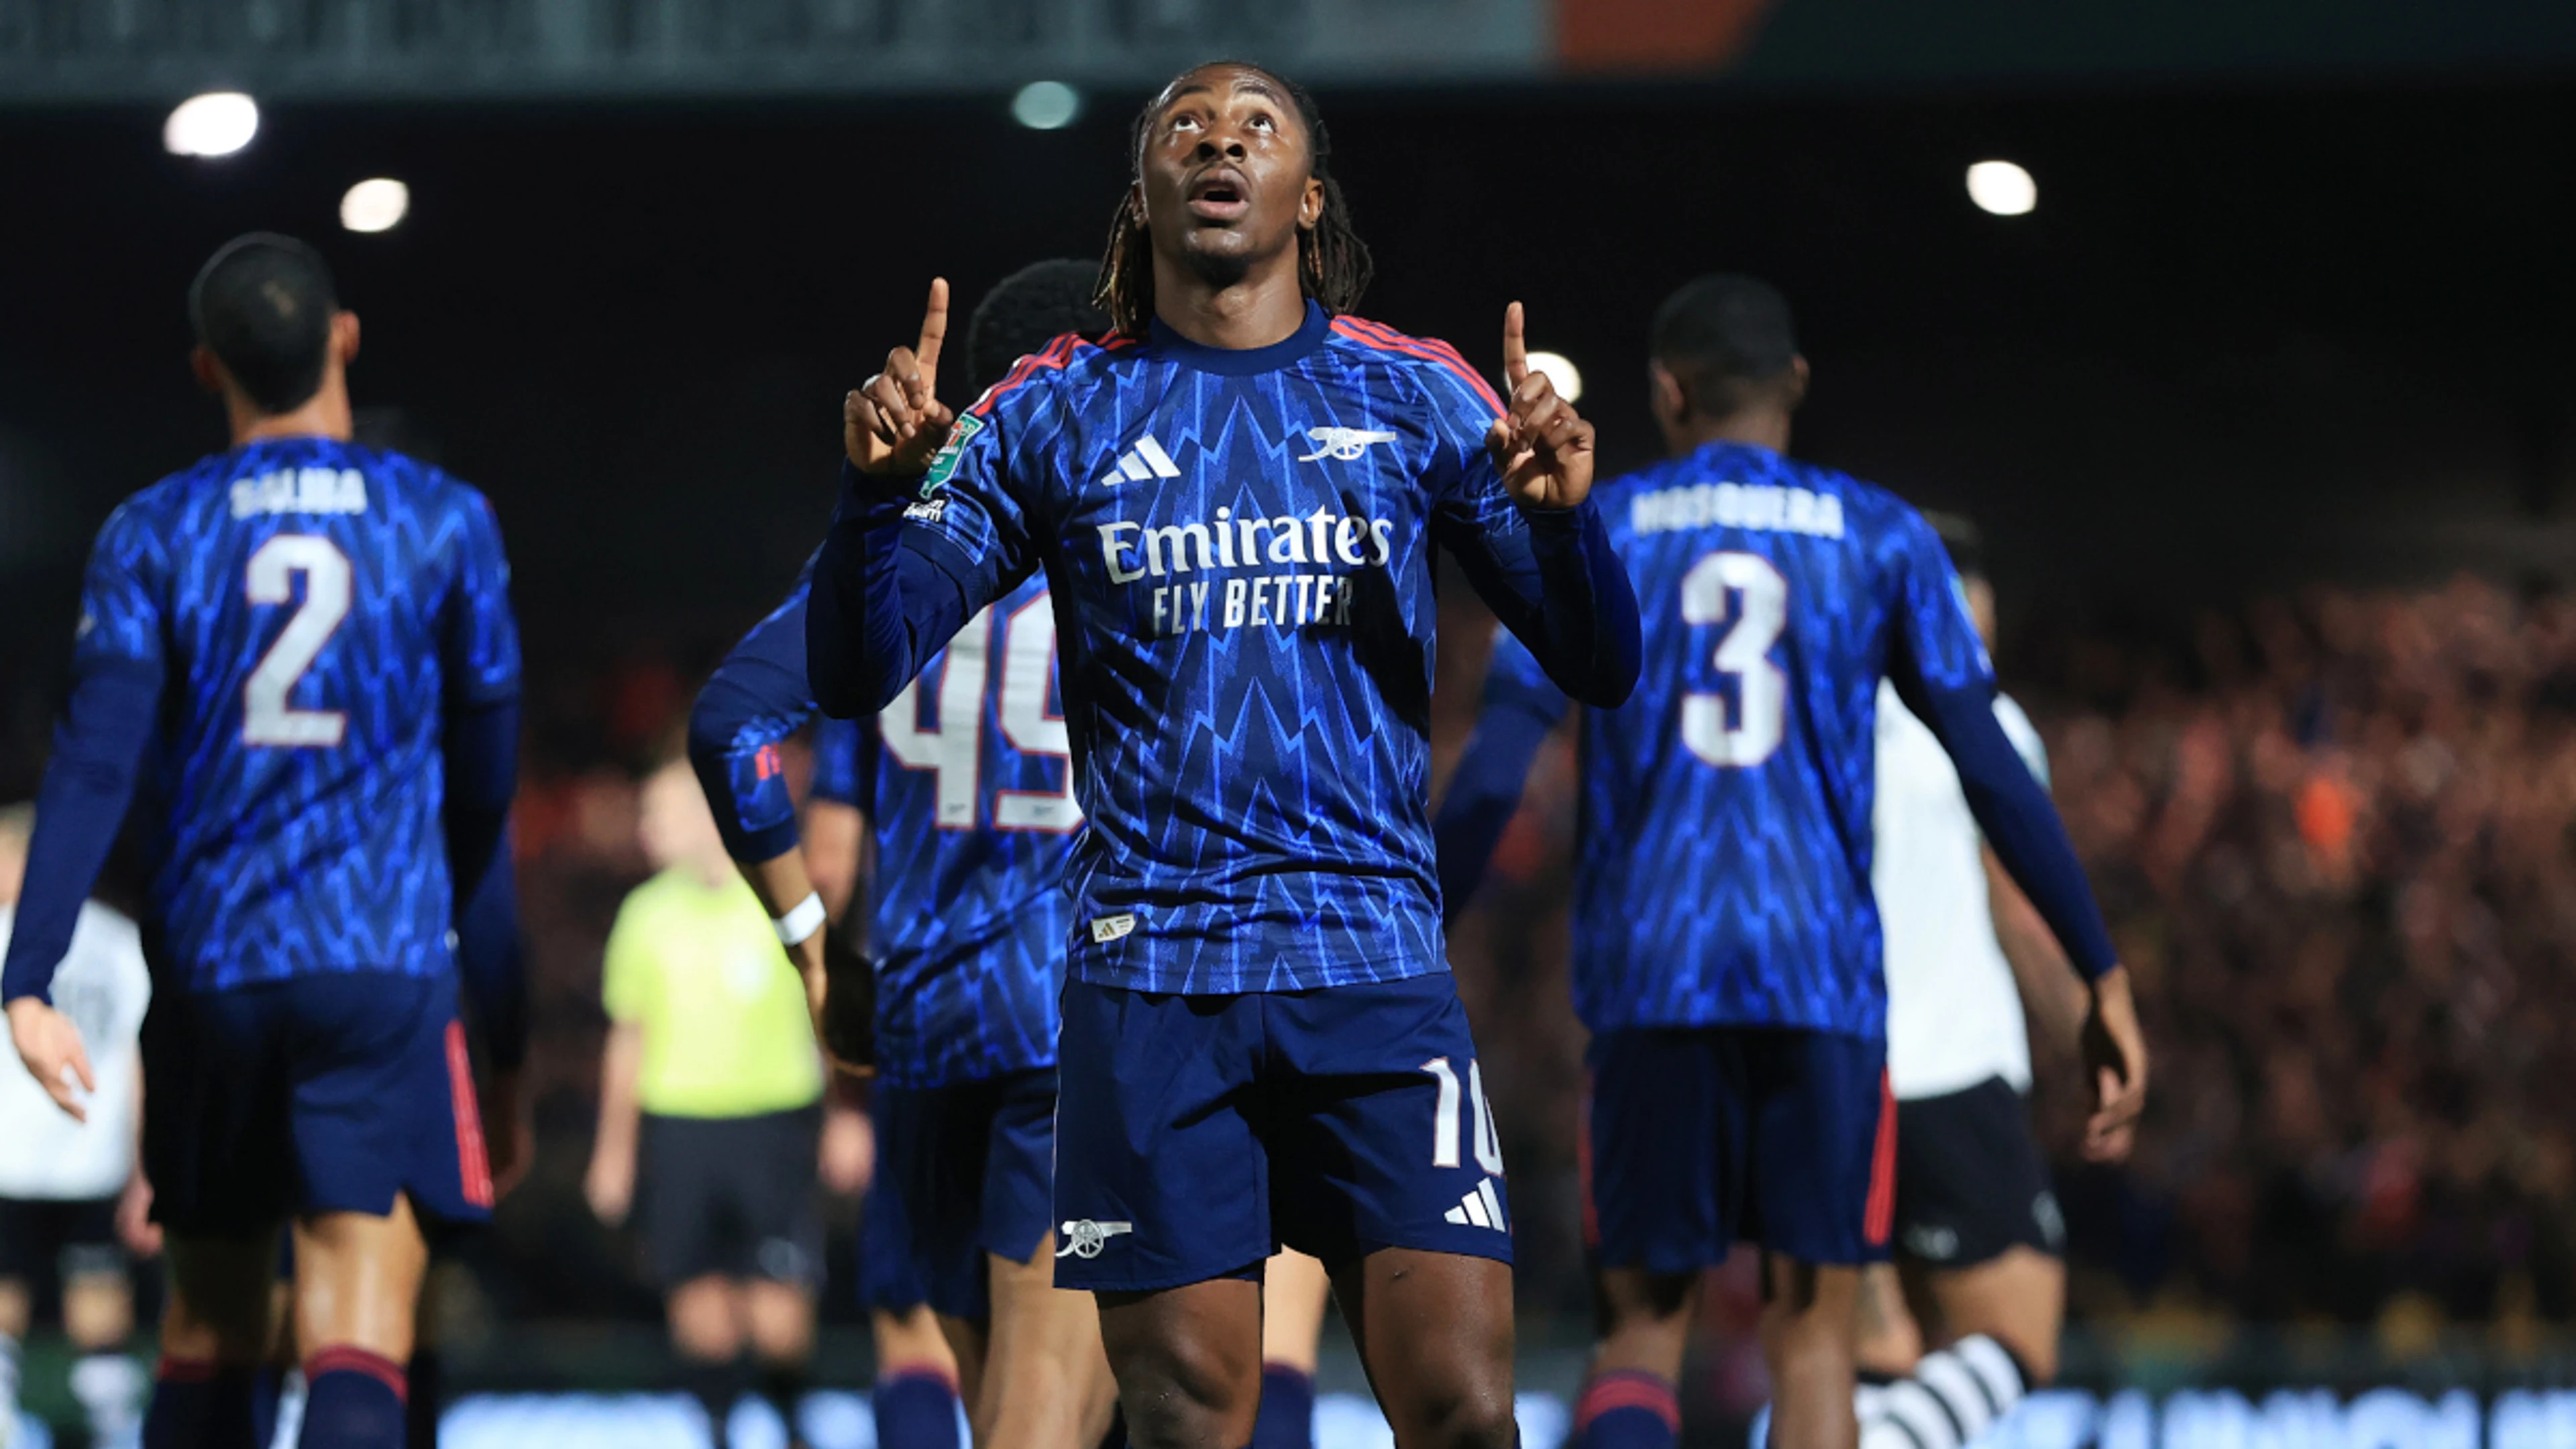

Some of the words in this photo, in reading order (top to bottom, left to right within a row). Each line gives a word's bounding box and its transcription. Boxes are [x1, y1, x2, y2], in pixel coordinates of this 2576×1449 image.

[1096, 504, 1393, 584] Emirates
[1154, 582, 1209, 637] FLY
[1223, 575, 1352, 628] BETTER
[243, 534, 354, 747] 2
[1681, 551, 1787, 767] 3
